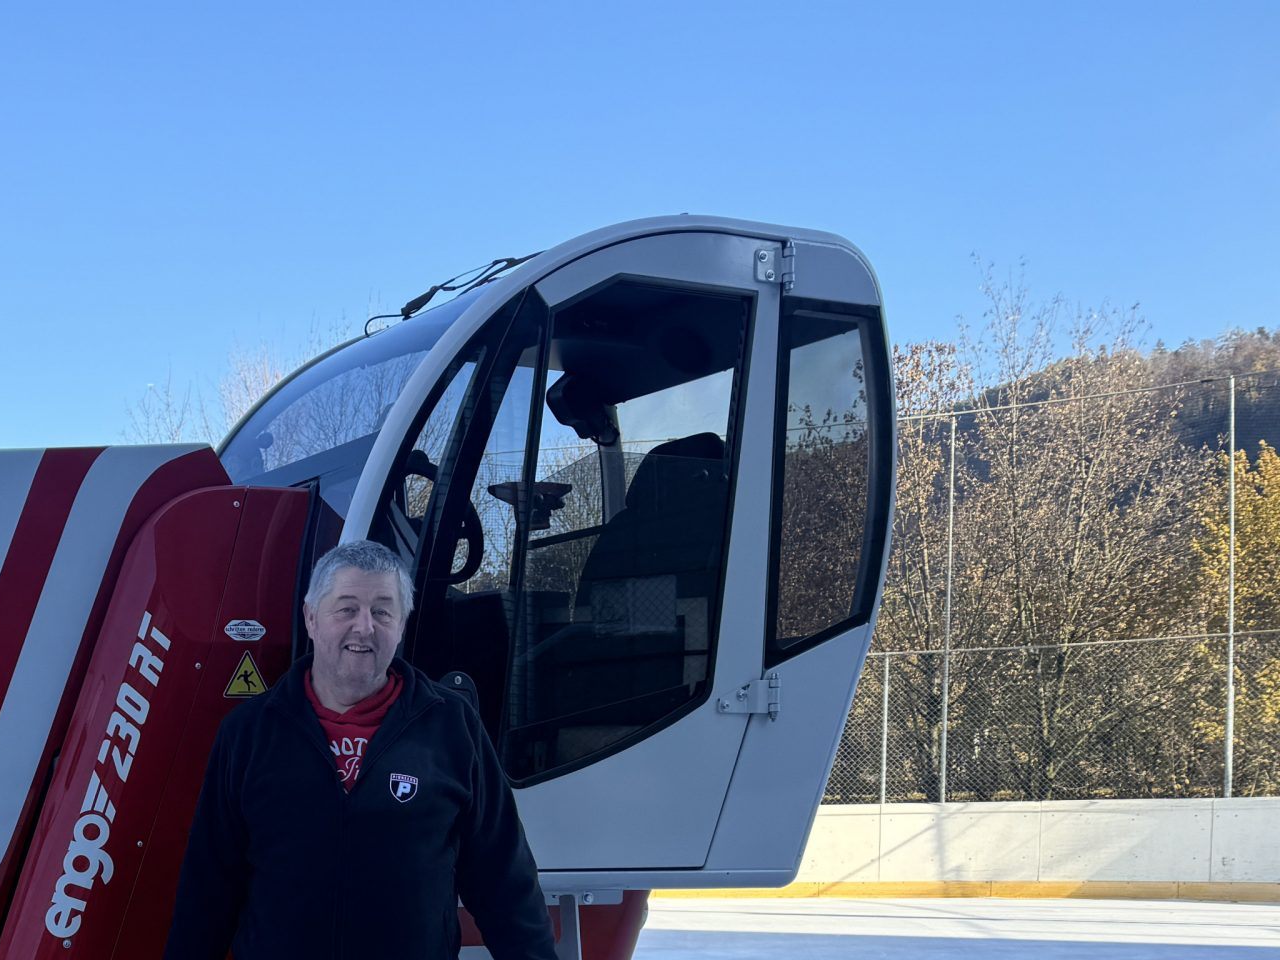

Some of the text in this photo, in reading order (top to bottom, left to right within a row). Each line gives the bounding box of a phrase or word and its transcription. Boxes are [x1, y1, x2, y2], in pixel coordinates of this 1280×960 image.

[44, 610, 172, 939] engo 230 RT
[396, 781, 412, 798] P
